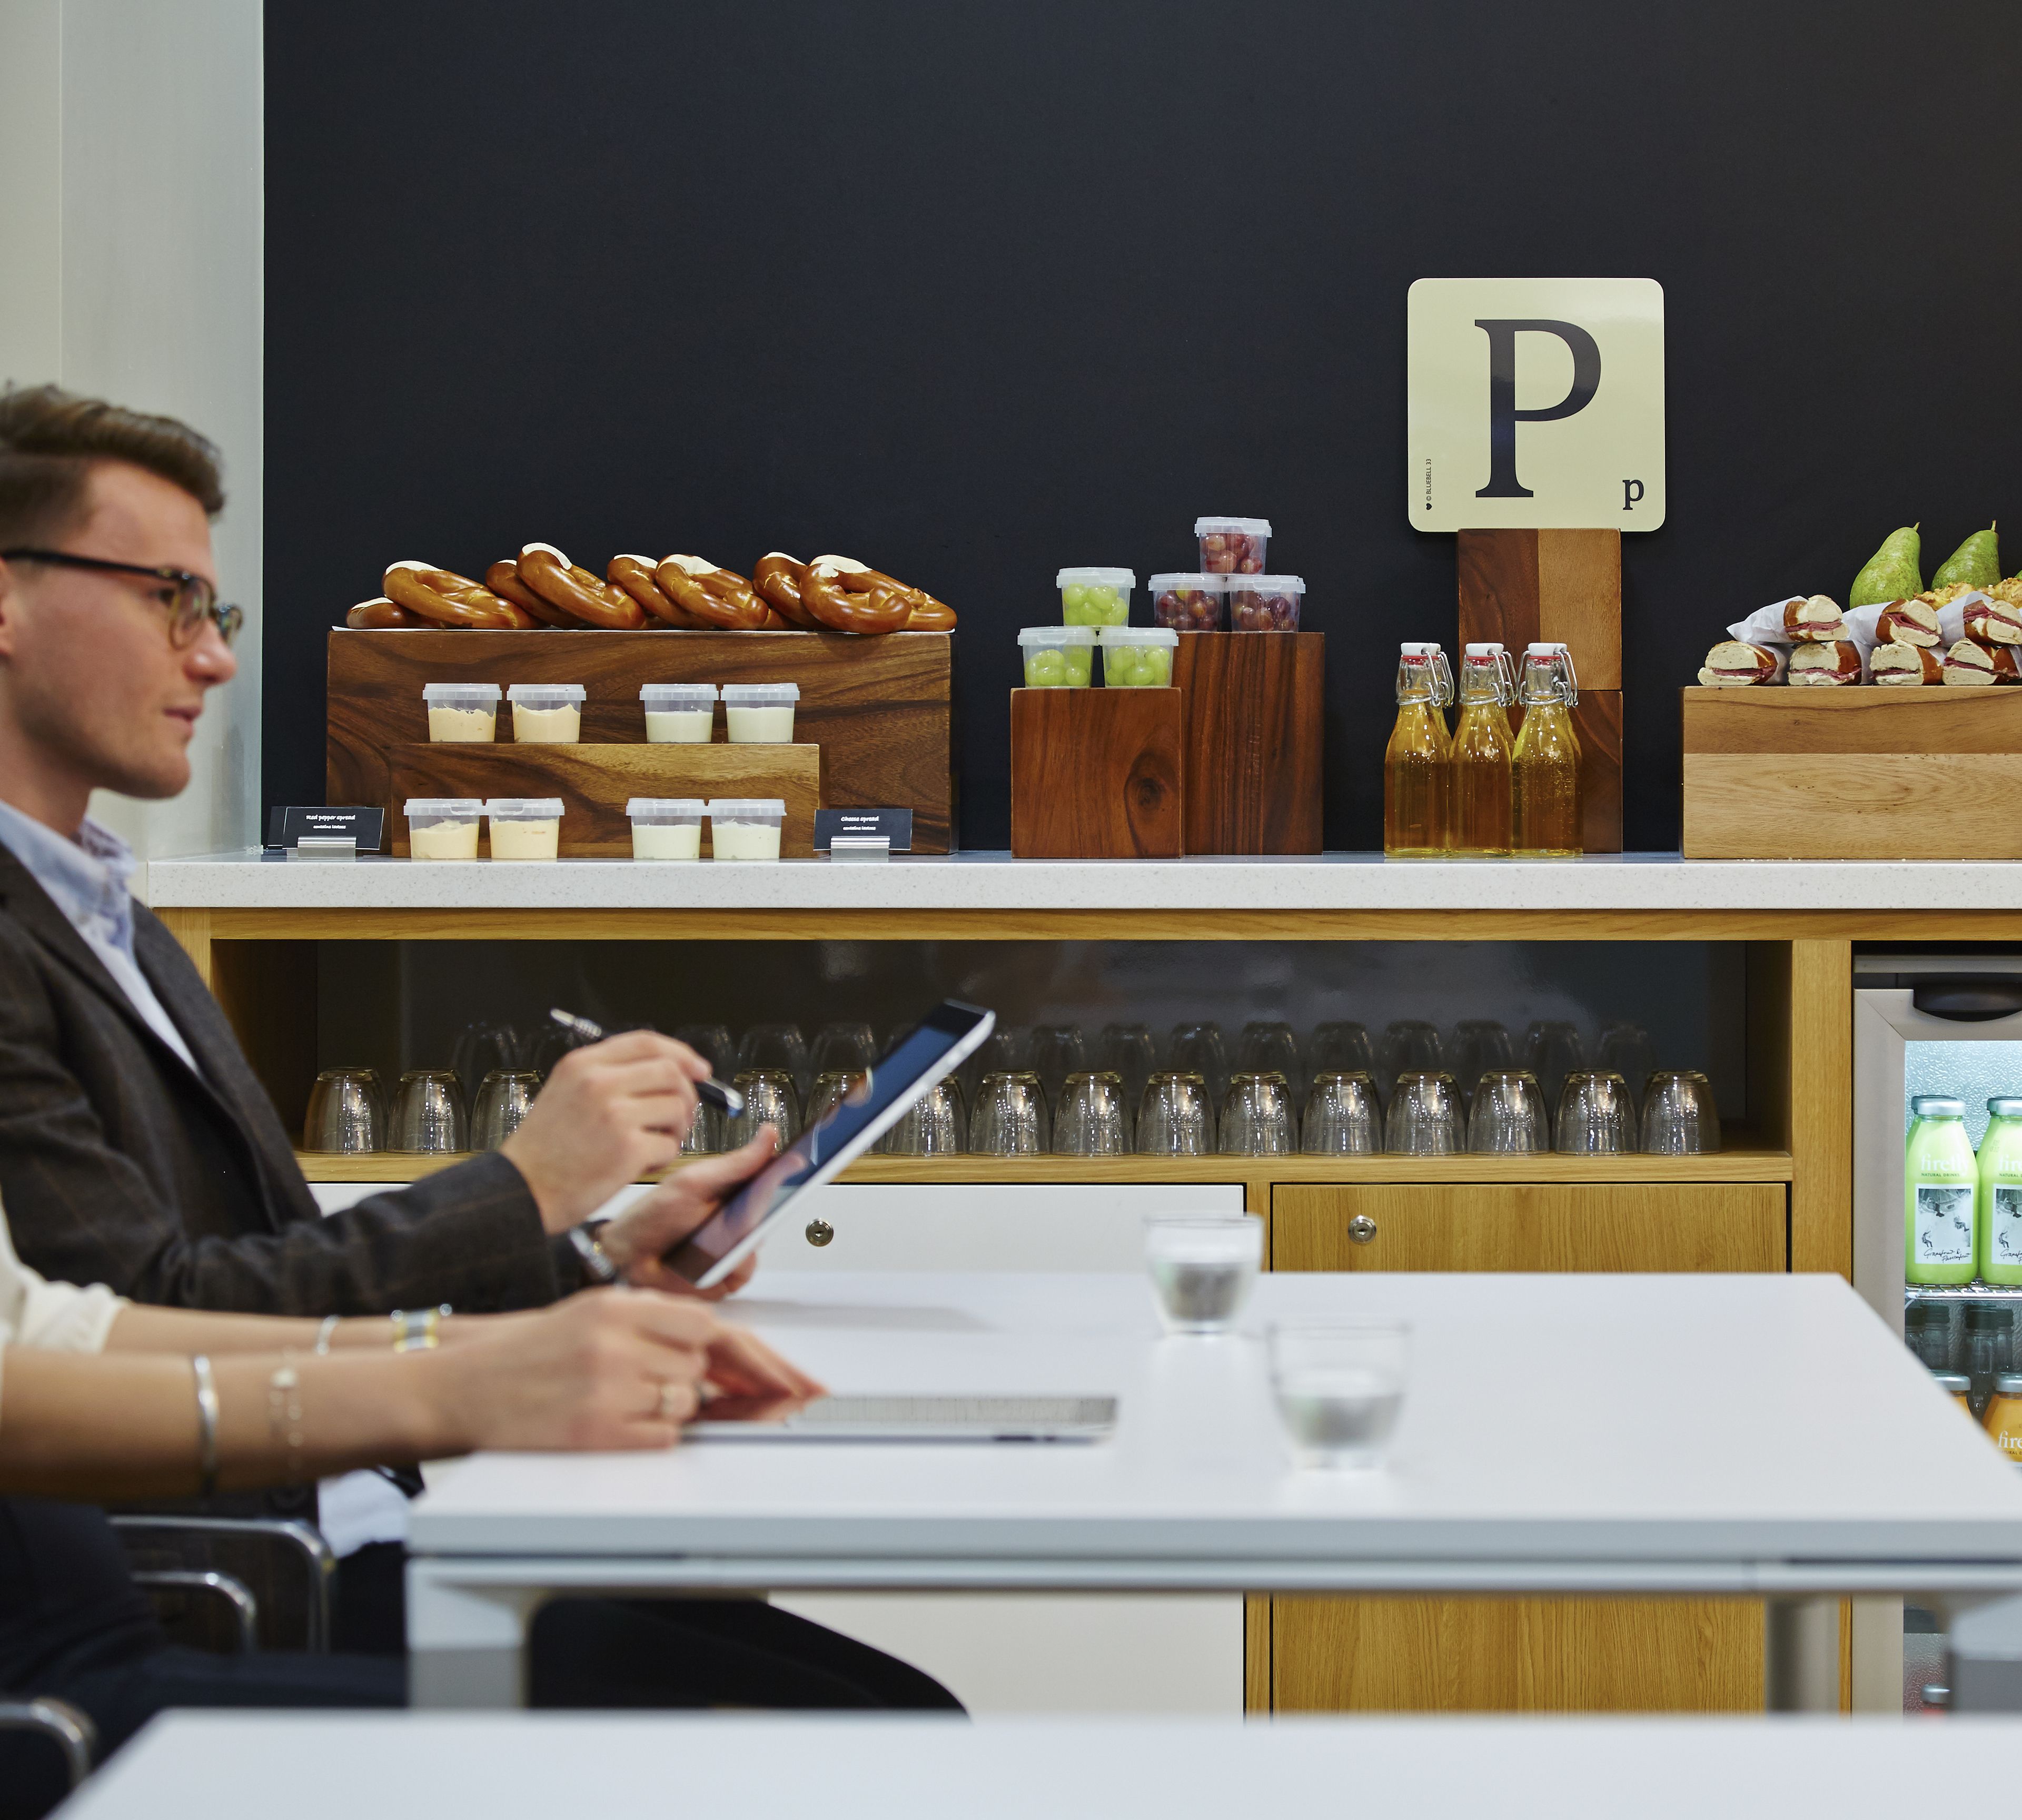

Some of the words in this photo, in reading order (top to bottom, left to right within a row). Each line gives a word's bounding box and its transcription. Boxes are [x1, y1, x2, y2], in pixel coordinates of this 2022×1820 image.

[1474, 319, 1601, 498] P
[1622, 479, 1644, 510] p
[1921, 1153, 1968, 1176] firefly
